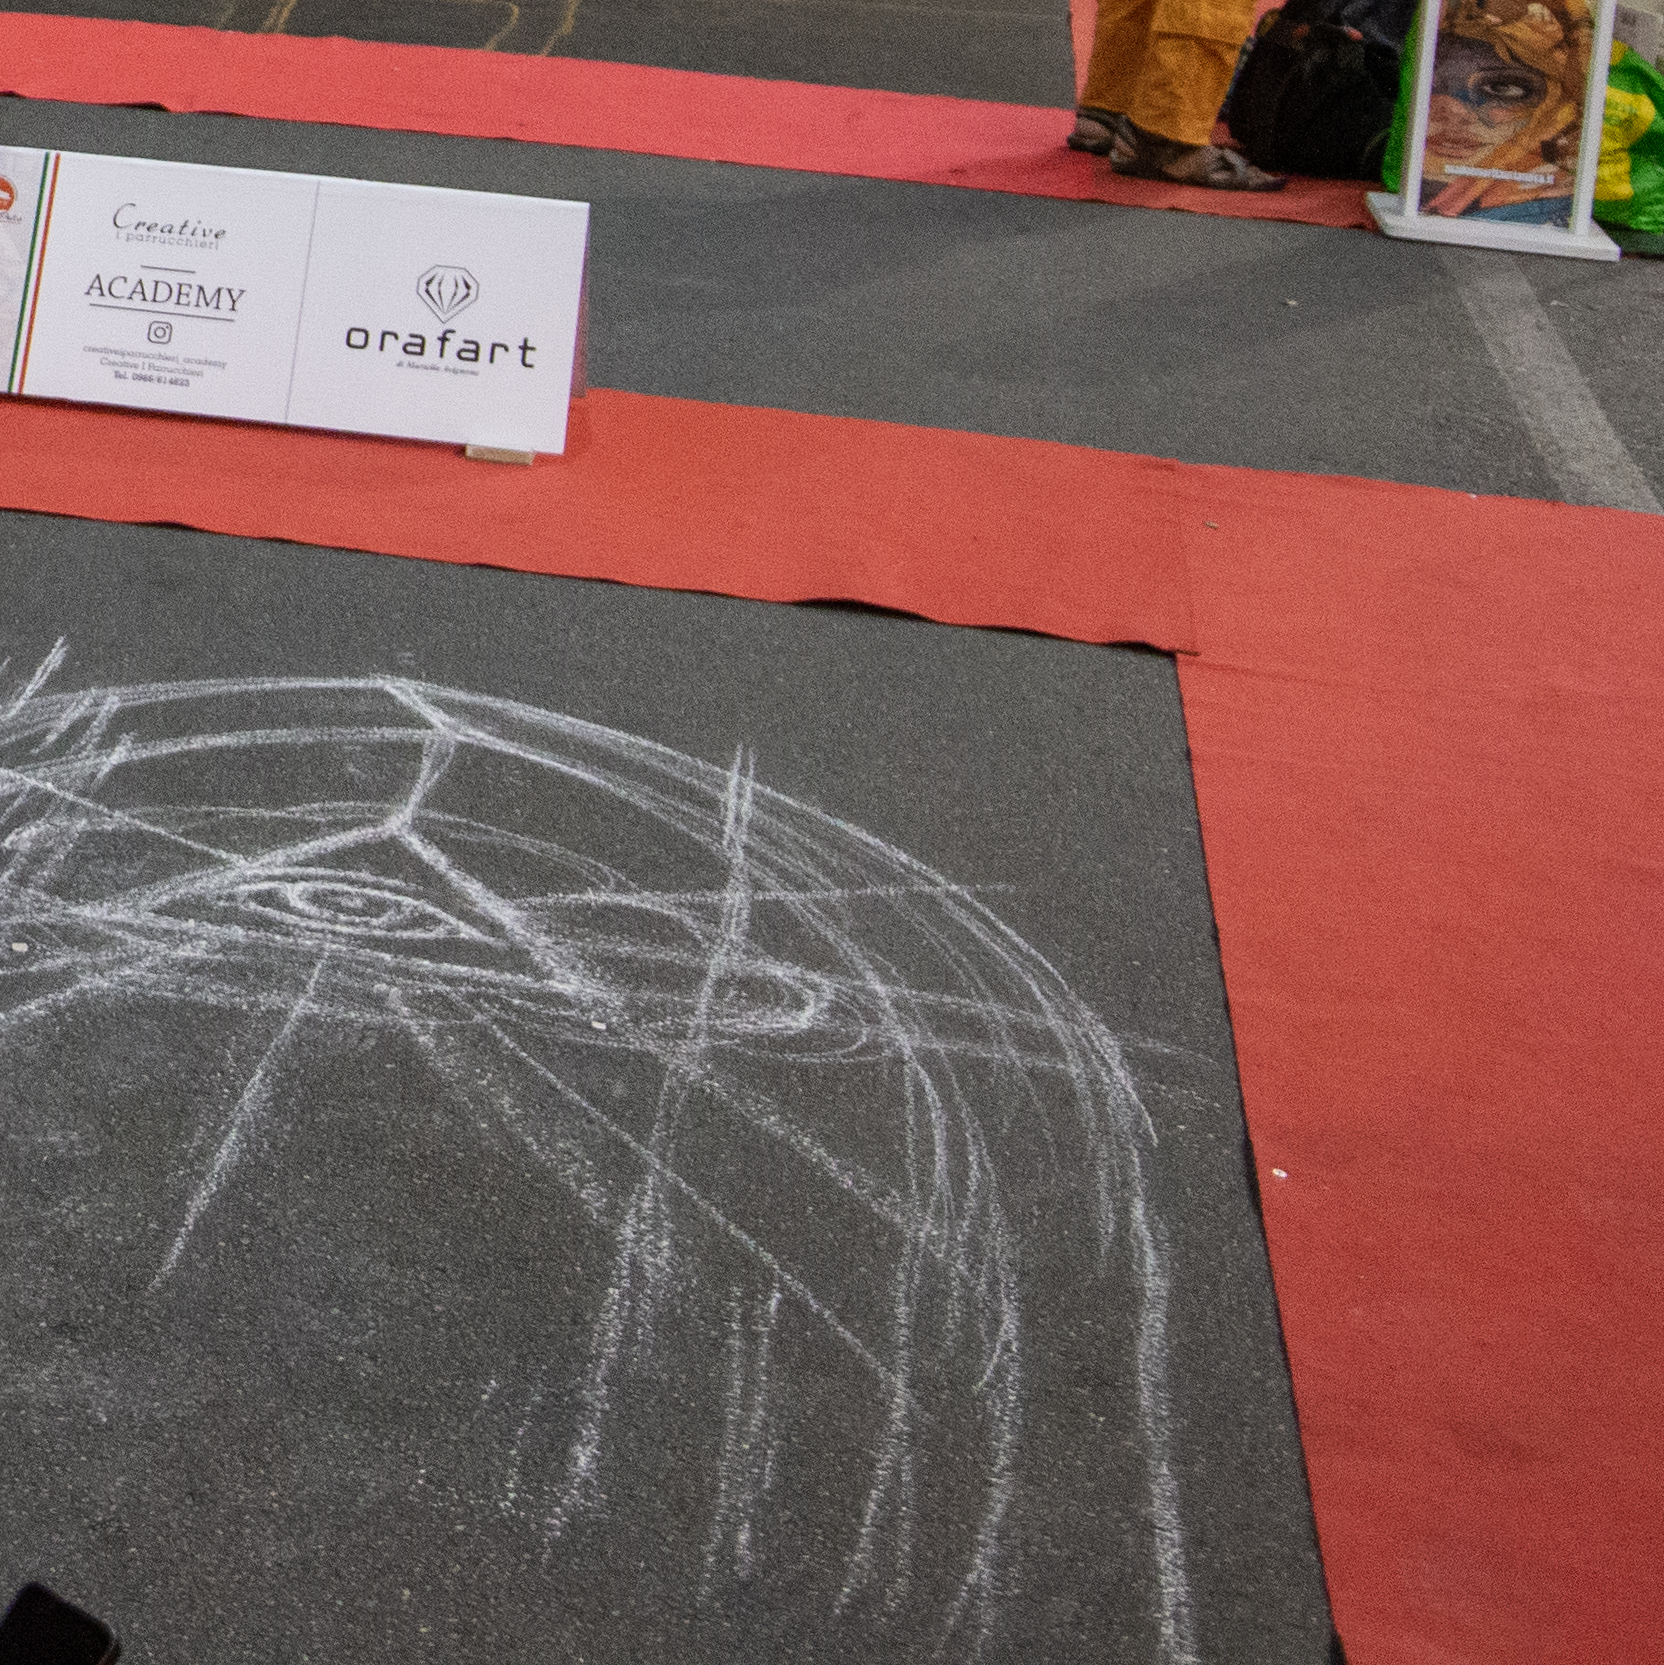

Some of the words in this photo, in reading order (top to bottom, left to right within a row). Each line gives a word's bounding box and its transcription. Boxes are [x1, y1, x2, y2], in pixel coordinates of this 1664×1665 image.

[112, 202, 227, 240] Creative
[125, 231, 220, 251] parrucchieri
[84, 273, 246, 312] ACADEMY
[345, 326, 537, 369] orafart
